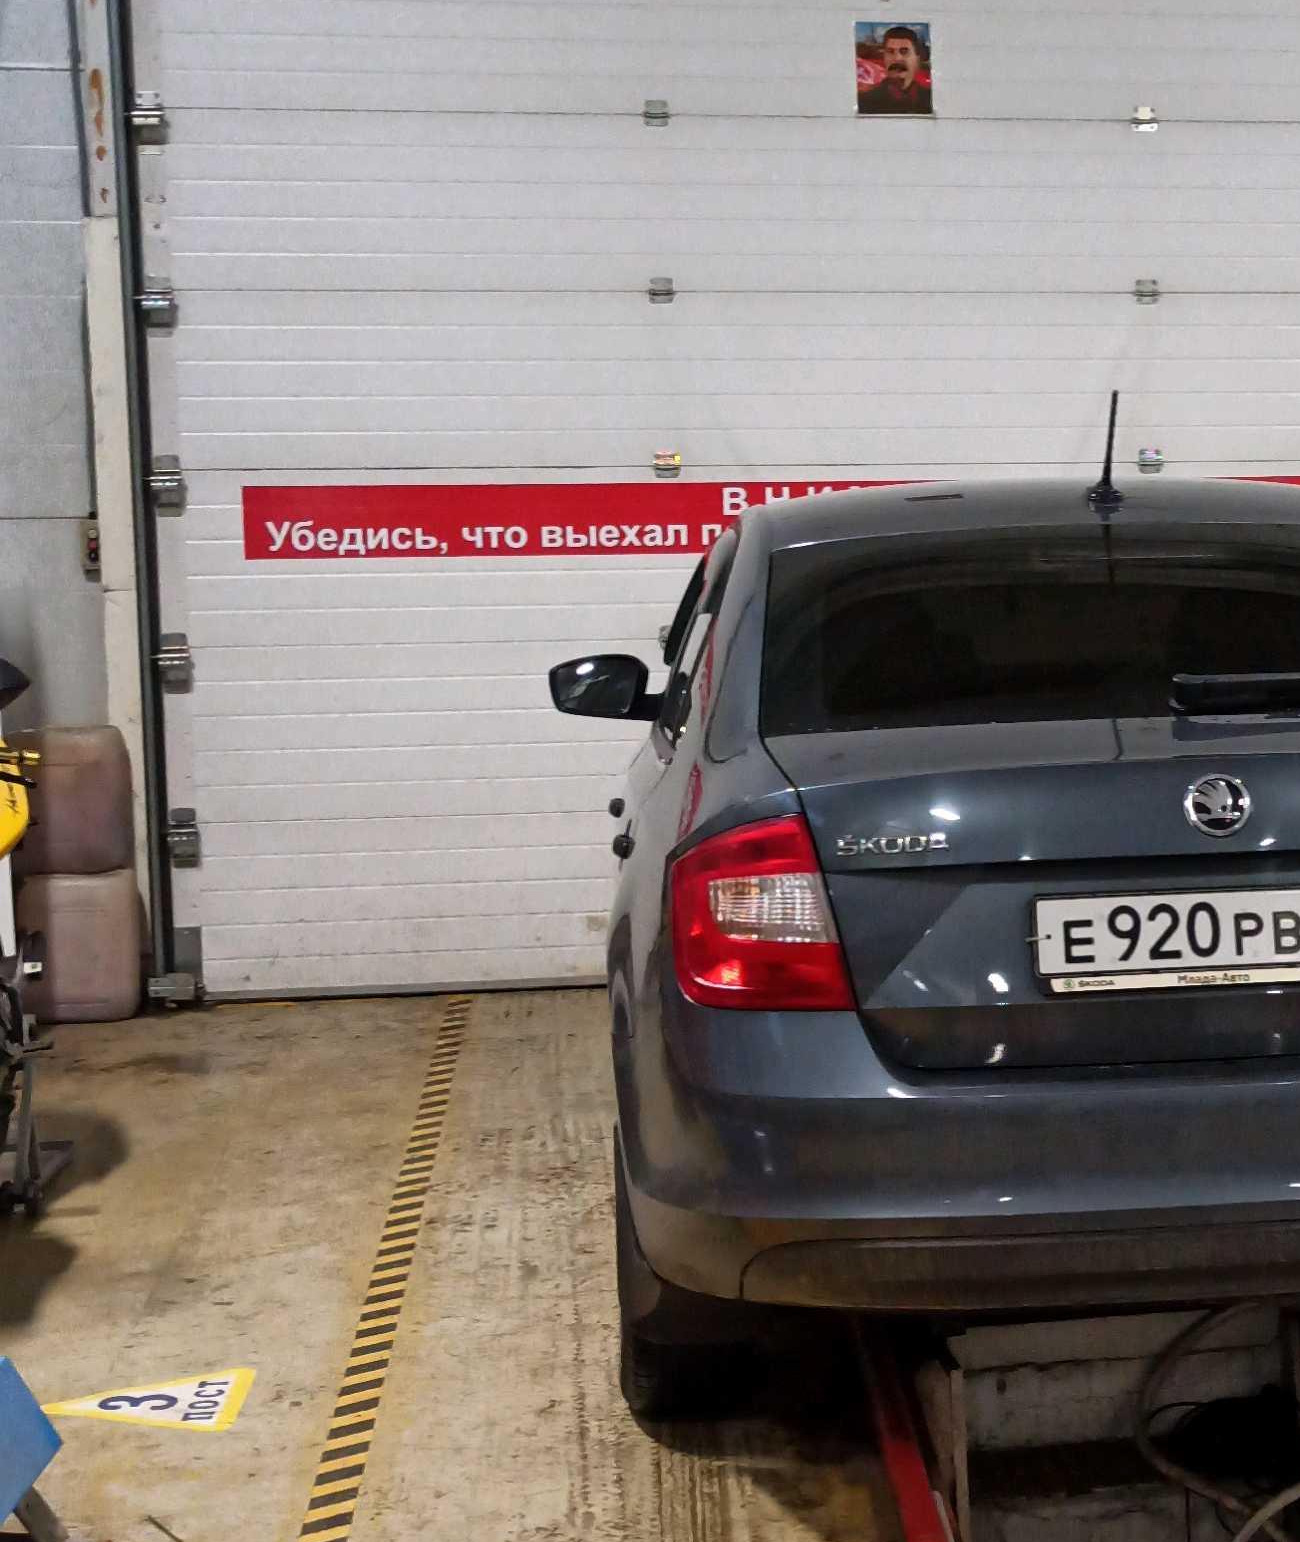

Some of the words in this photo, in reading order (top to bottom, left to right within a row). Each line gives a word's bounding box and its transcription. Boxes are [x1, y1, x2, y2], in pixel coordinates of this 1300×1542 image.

[265, 520, 448, 556] Убедись,
[461, 525, 529, 548] что
[541, 523, 689, 549] выехал
[97, 1393, 179, 1411] 3
[181, 1379, 229, 1422] ПОСТ
